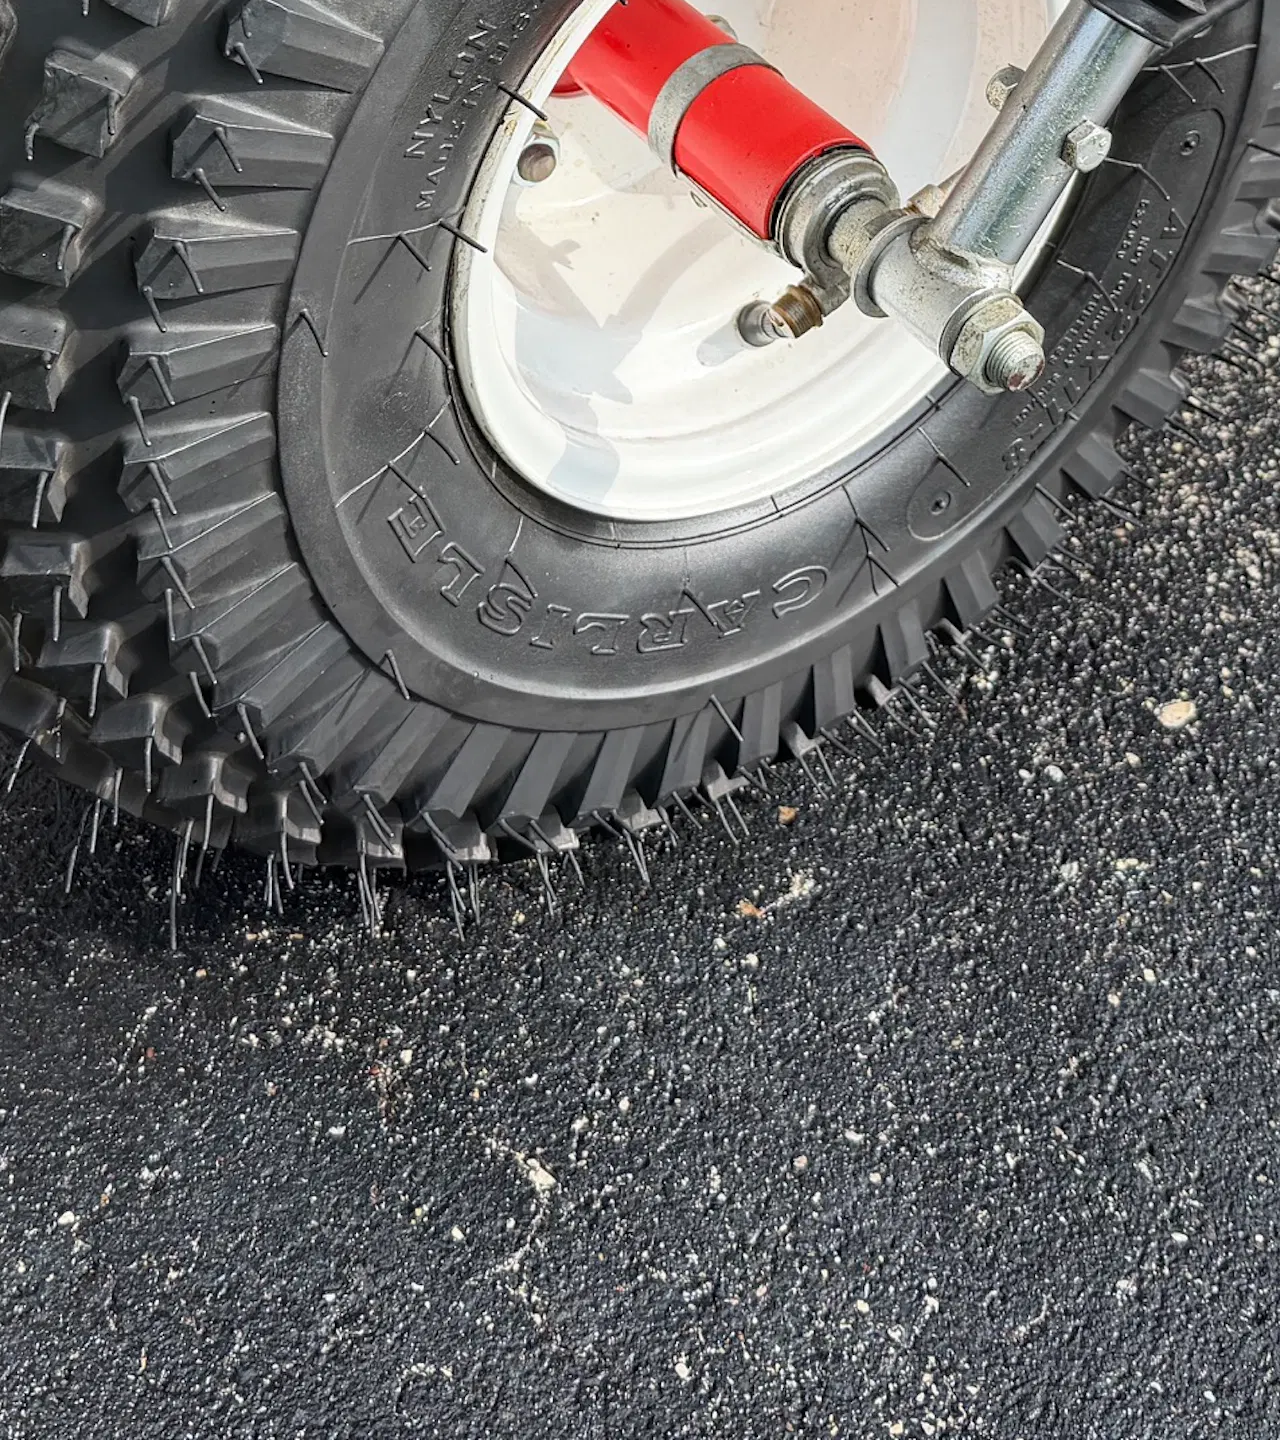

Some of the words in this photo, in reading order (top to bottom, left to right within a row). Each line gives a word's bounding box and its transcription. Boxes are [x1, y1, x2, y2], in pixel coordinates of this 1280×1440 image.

[403, 18, 498, 159] NYLON
[415, 120, 466, 211] MADE
[461, 74, 492, 108] IN
[387, 485, 829, 655] CARLISLE
